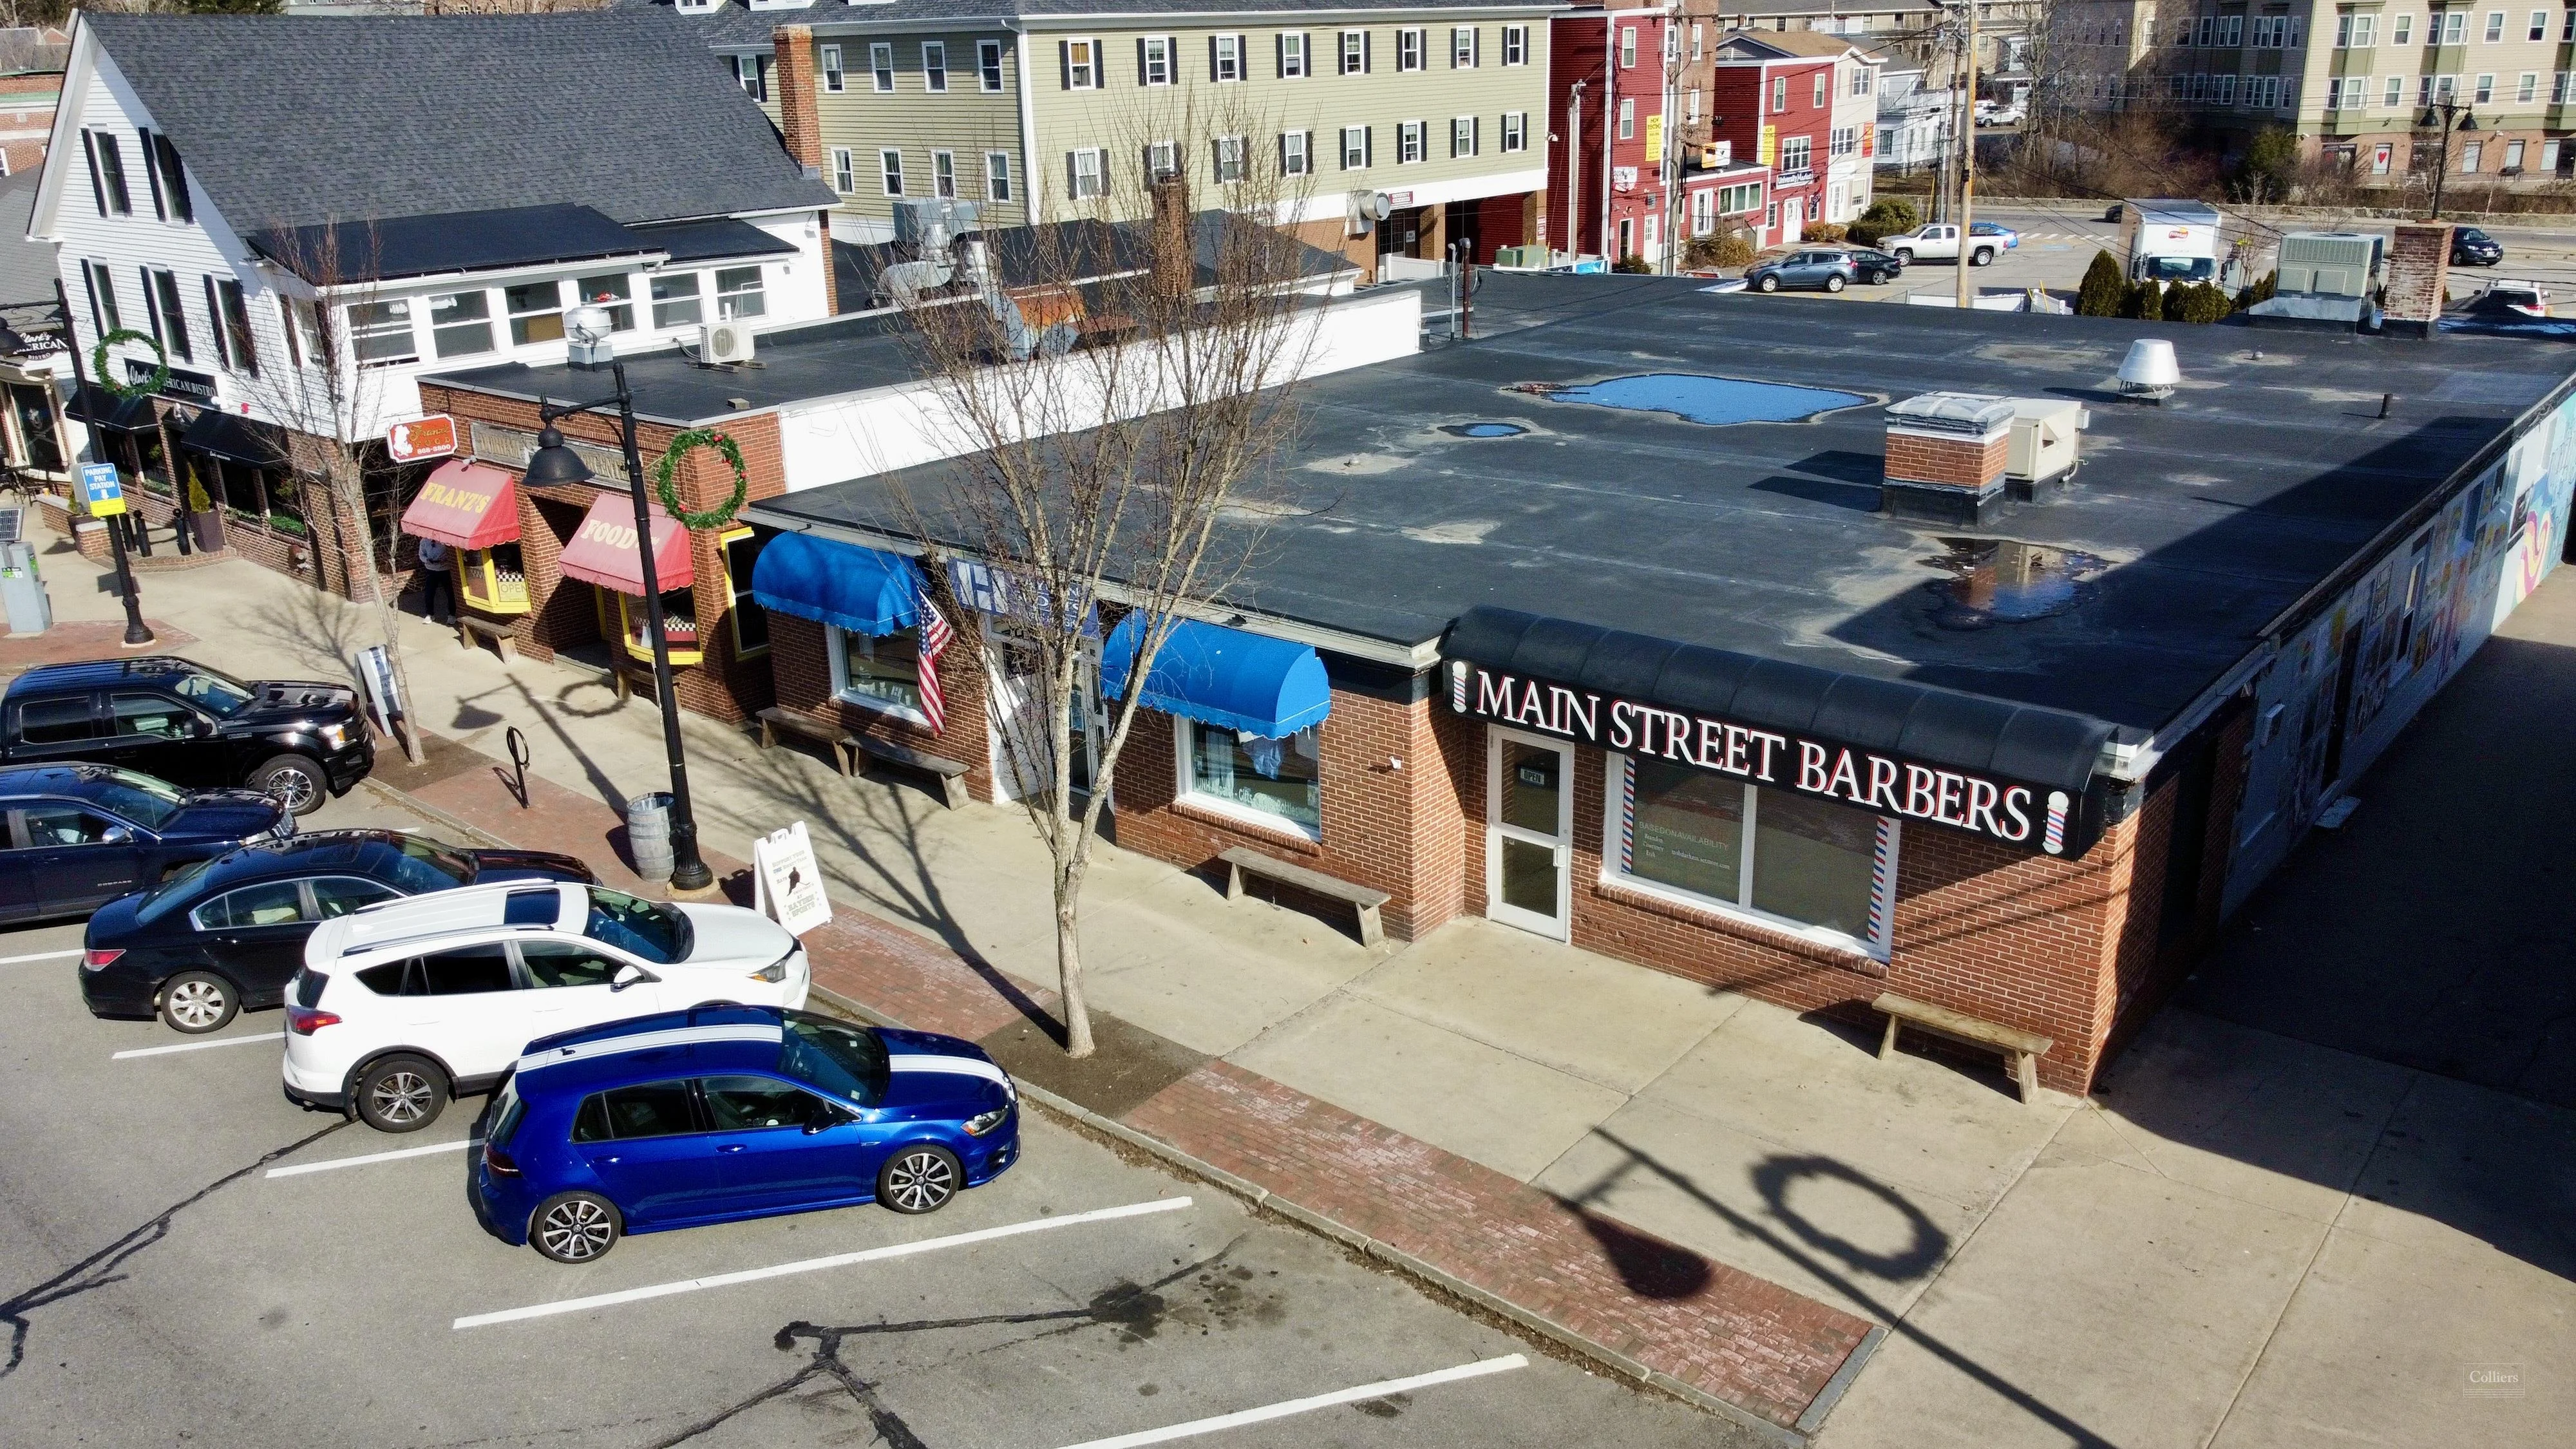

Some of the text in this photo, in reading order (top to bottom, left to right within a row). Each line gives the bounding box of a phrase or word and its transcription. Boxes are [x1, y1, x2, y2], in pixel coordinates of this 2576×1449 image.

[1779, 174, 1798, 185] University
[192, 383, 216, 397] BISTRO
[414, 437, 451, 448] FOOD
[84, 466, 113, 477] PARKING
[90, 481, 115, 490] STATION
[420, 482, 491, 513] FRANZ'S
[500, 583, 527, 593] OPEN
[1476, 669, 2032, 841] MAIN STREET BARBERS
[1524, 770, 1541, 783] OPEN
[1197, 777, 1211, 791] UNH
[1238, 788, 1253, 804] Gifts
[788, 894, 815, 911] HAYDEN
